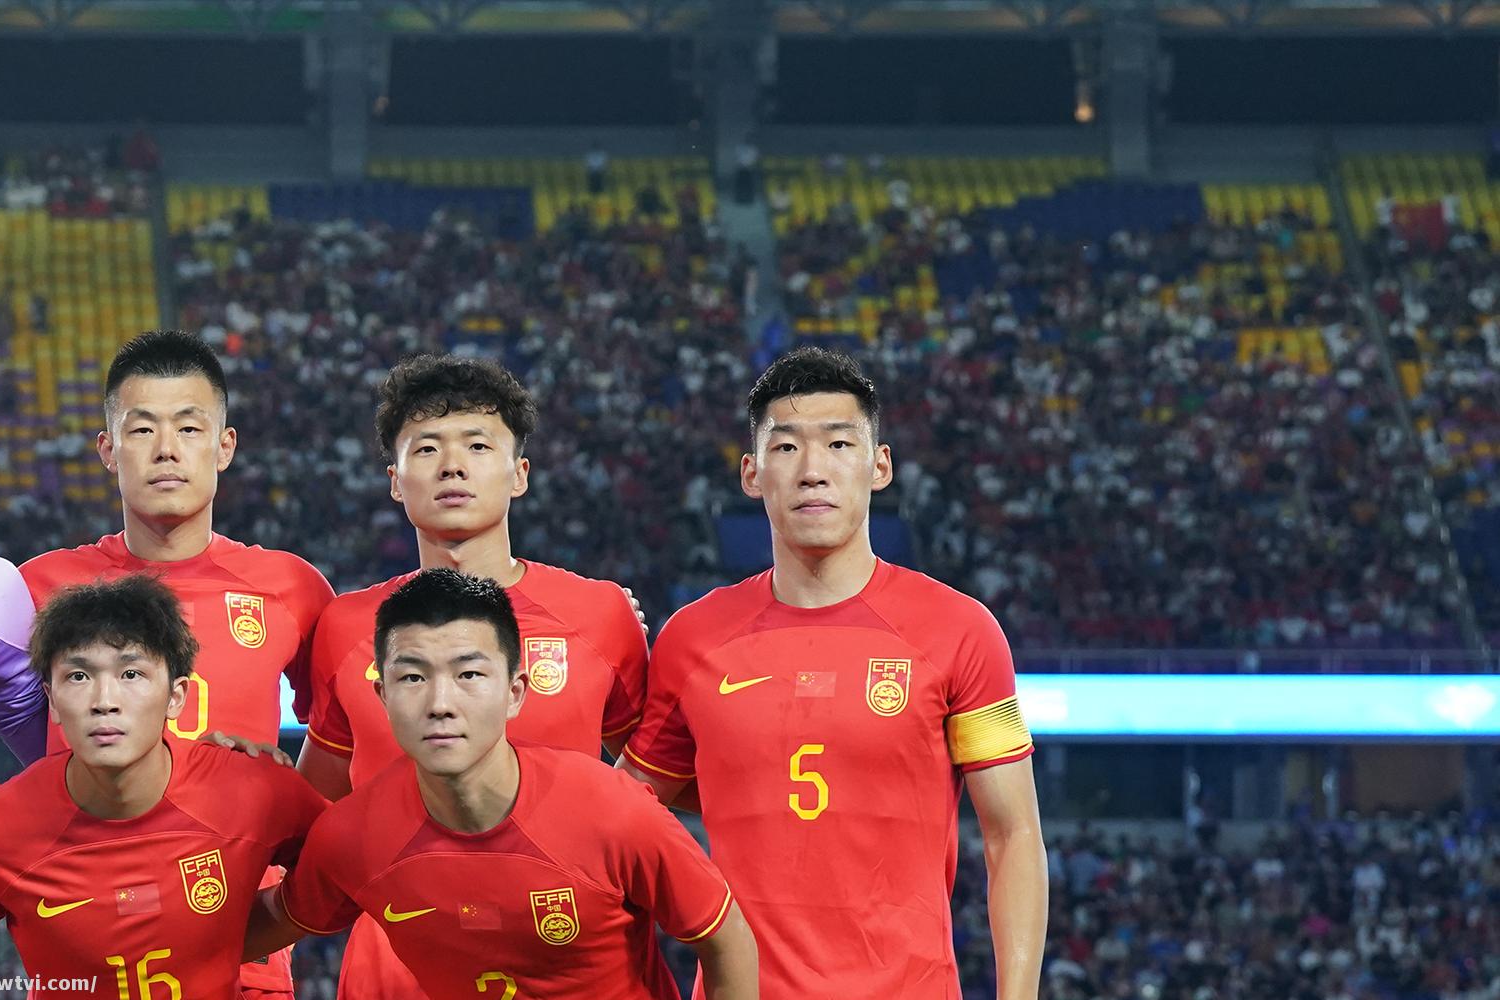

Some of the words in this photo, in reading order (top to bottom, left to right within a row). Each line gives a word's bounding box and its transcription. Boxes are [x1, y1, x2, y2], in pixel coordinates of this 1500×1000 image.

[231, 598, 260, 610] CFA
[528, 641, 561, 651] CFA
[872, 662, 907, 673] CFA
[789, 744, 828, 820] 5
[183, 854, 218, 873] CFA
[535, 891, 570, 906] CFA
